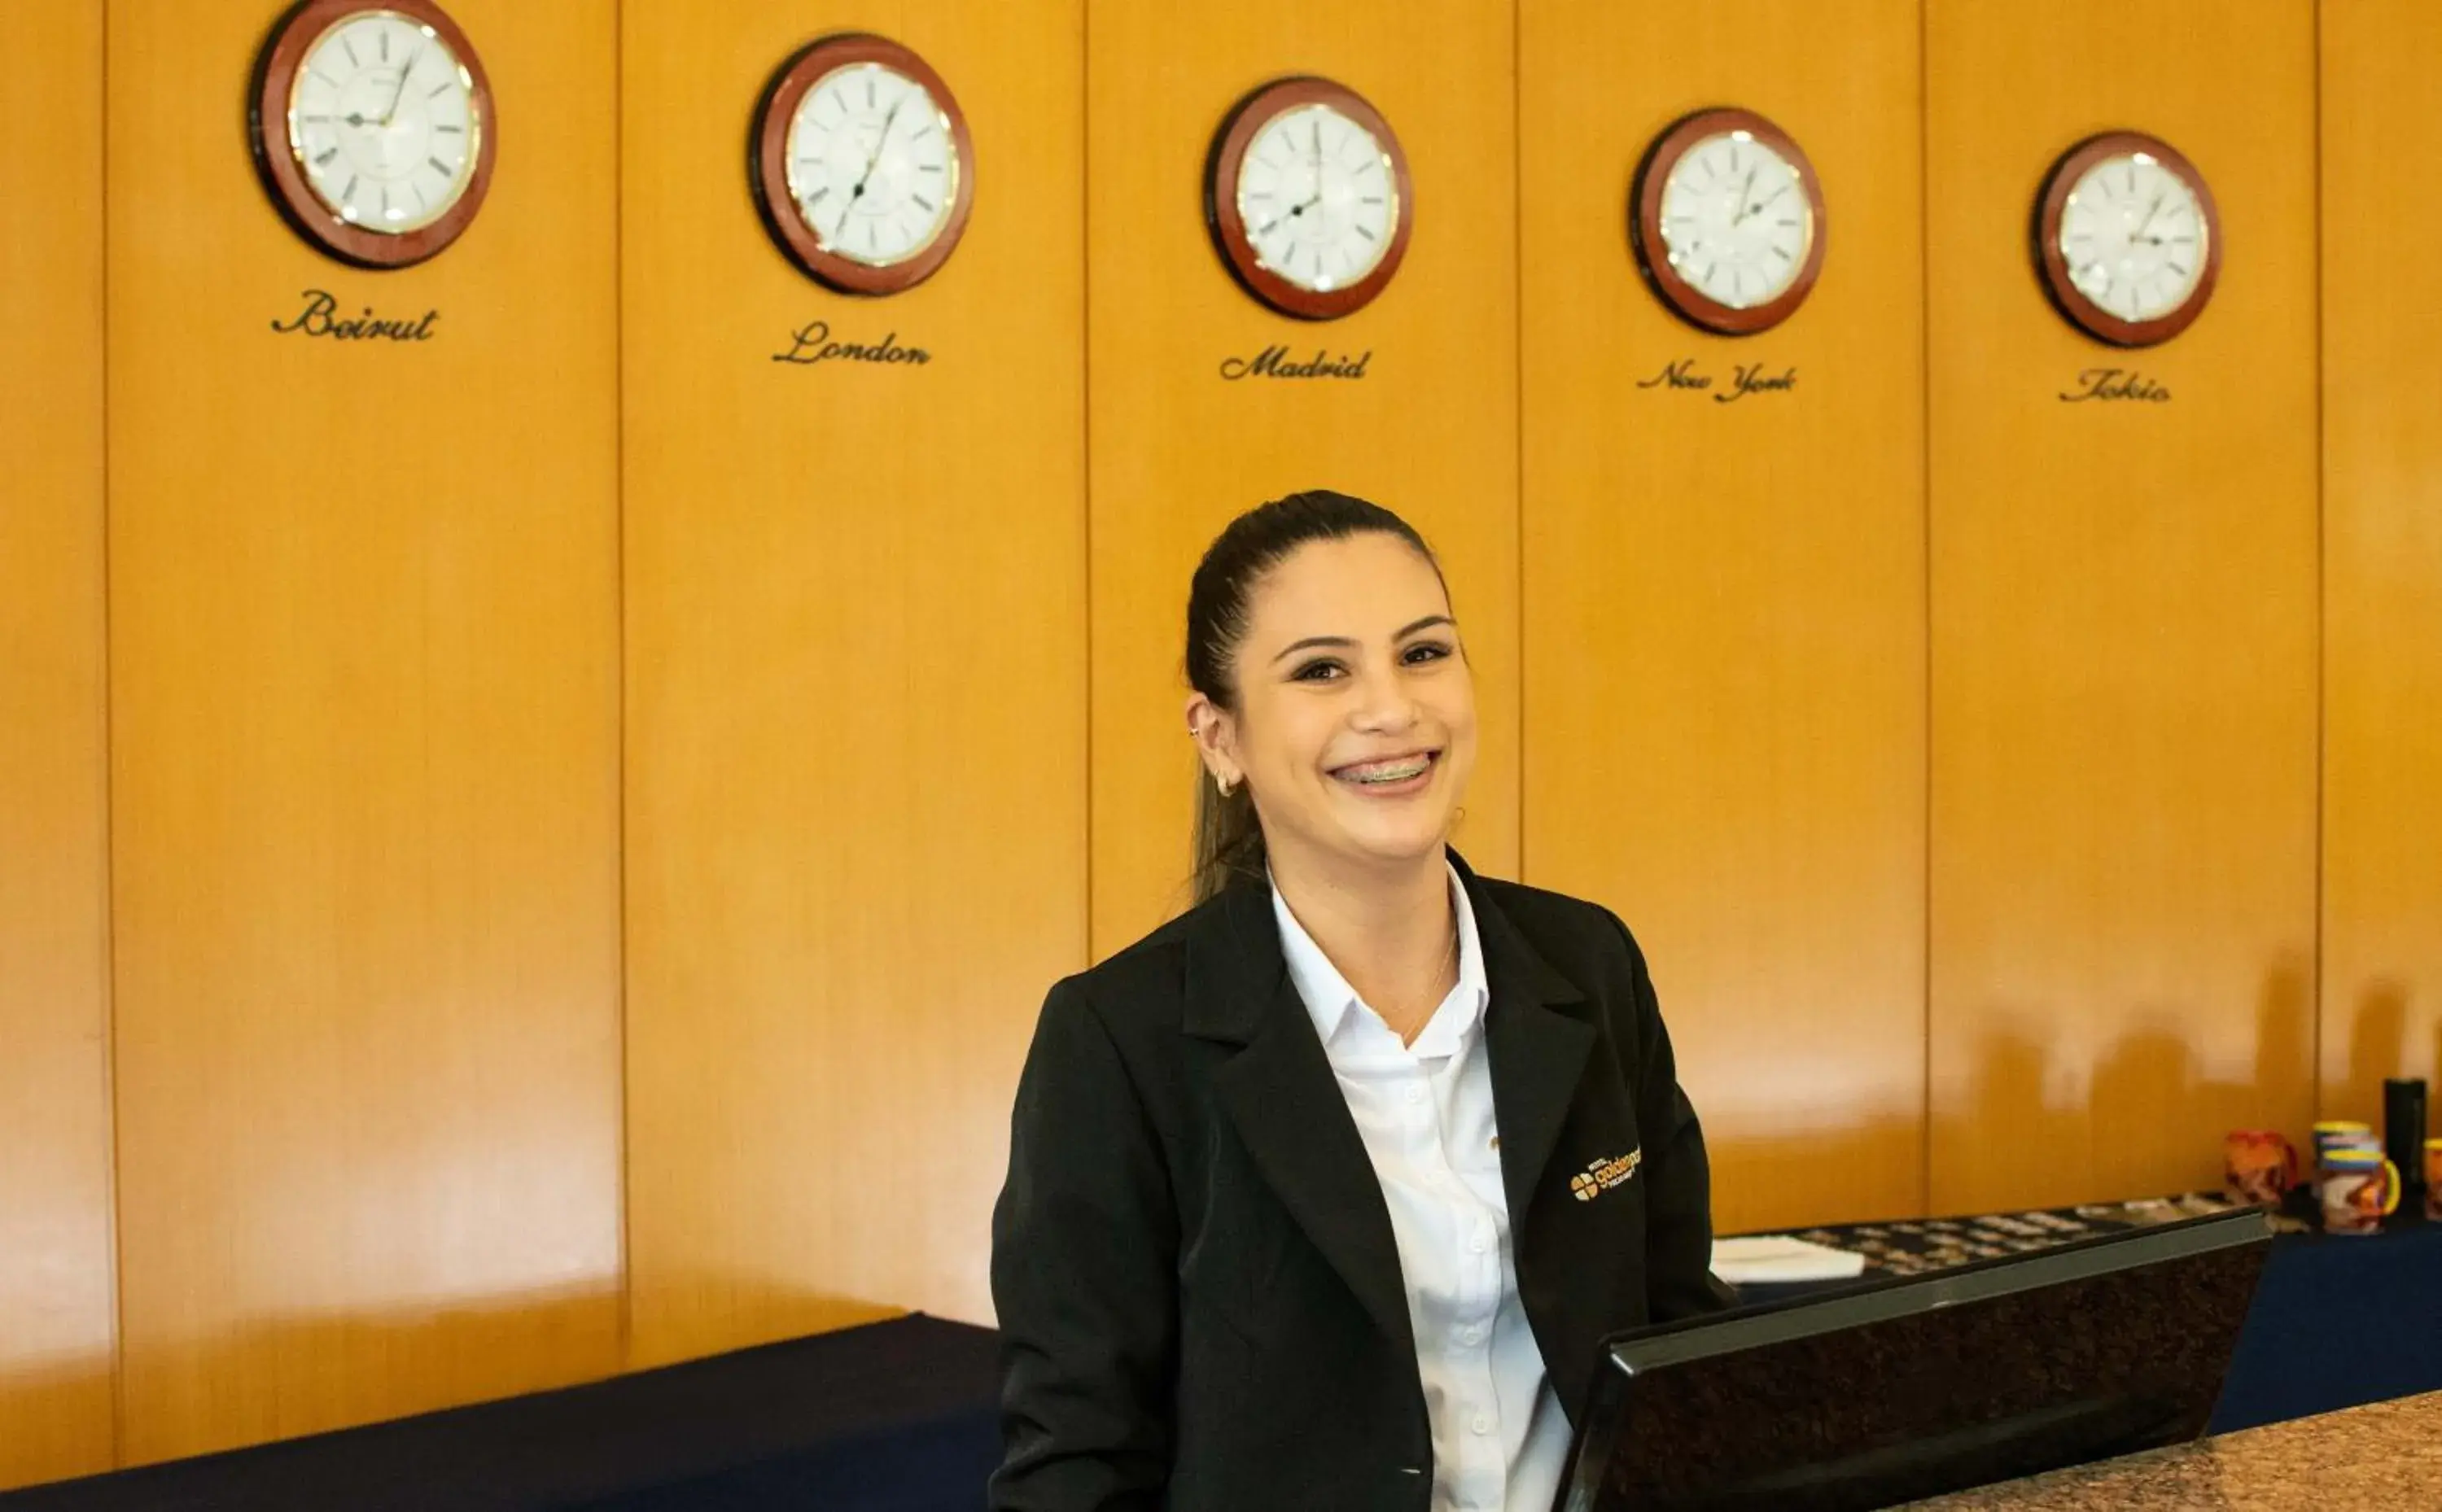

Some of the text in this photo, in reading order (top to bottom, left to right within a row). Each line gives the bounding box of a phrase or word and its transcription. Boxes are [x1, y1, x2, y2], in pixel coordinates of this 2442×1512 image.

[270, 289, 440, 342] Beirut
[771, 321, 930, 365] London
[1220, 345, 1372, 380] Madrid
[1636, 359, 1796, 402] New York
[2059, 369, 2171, 401] Tokio
